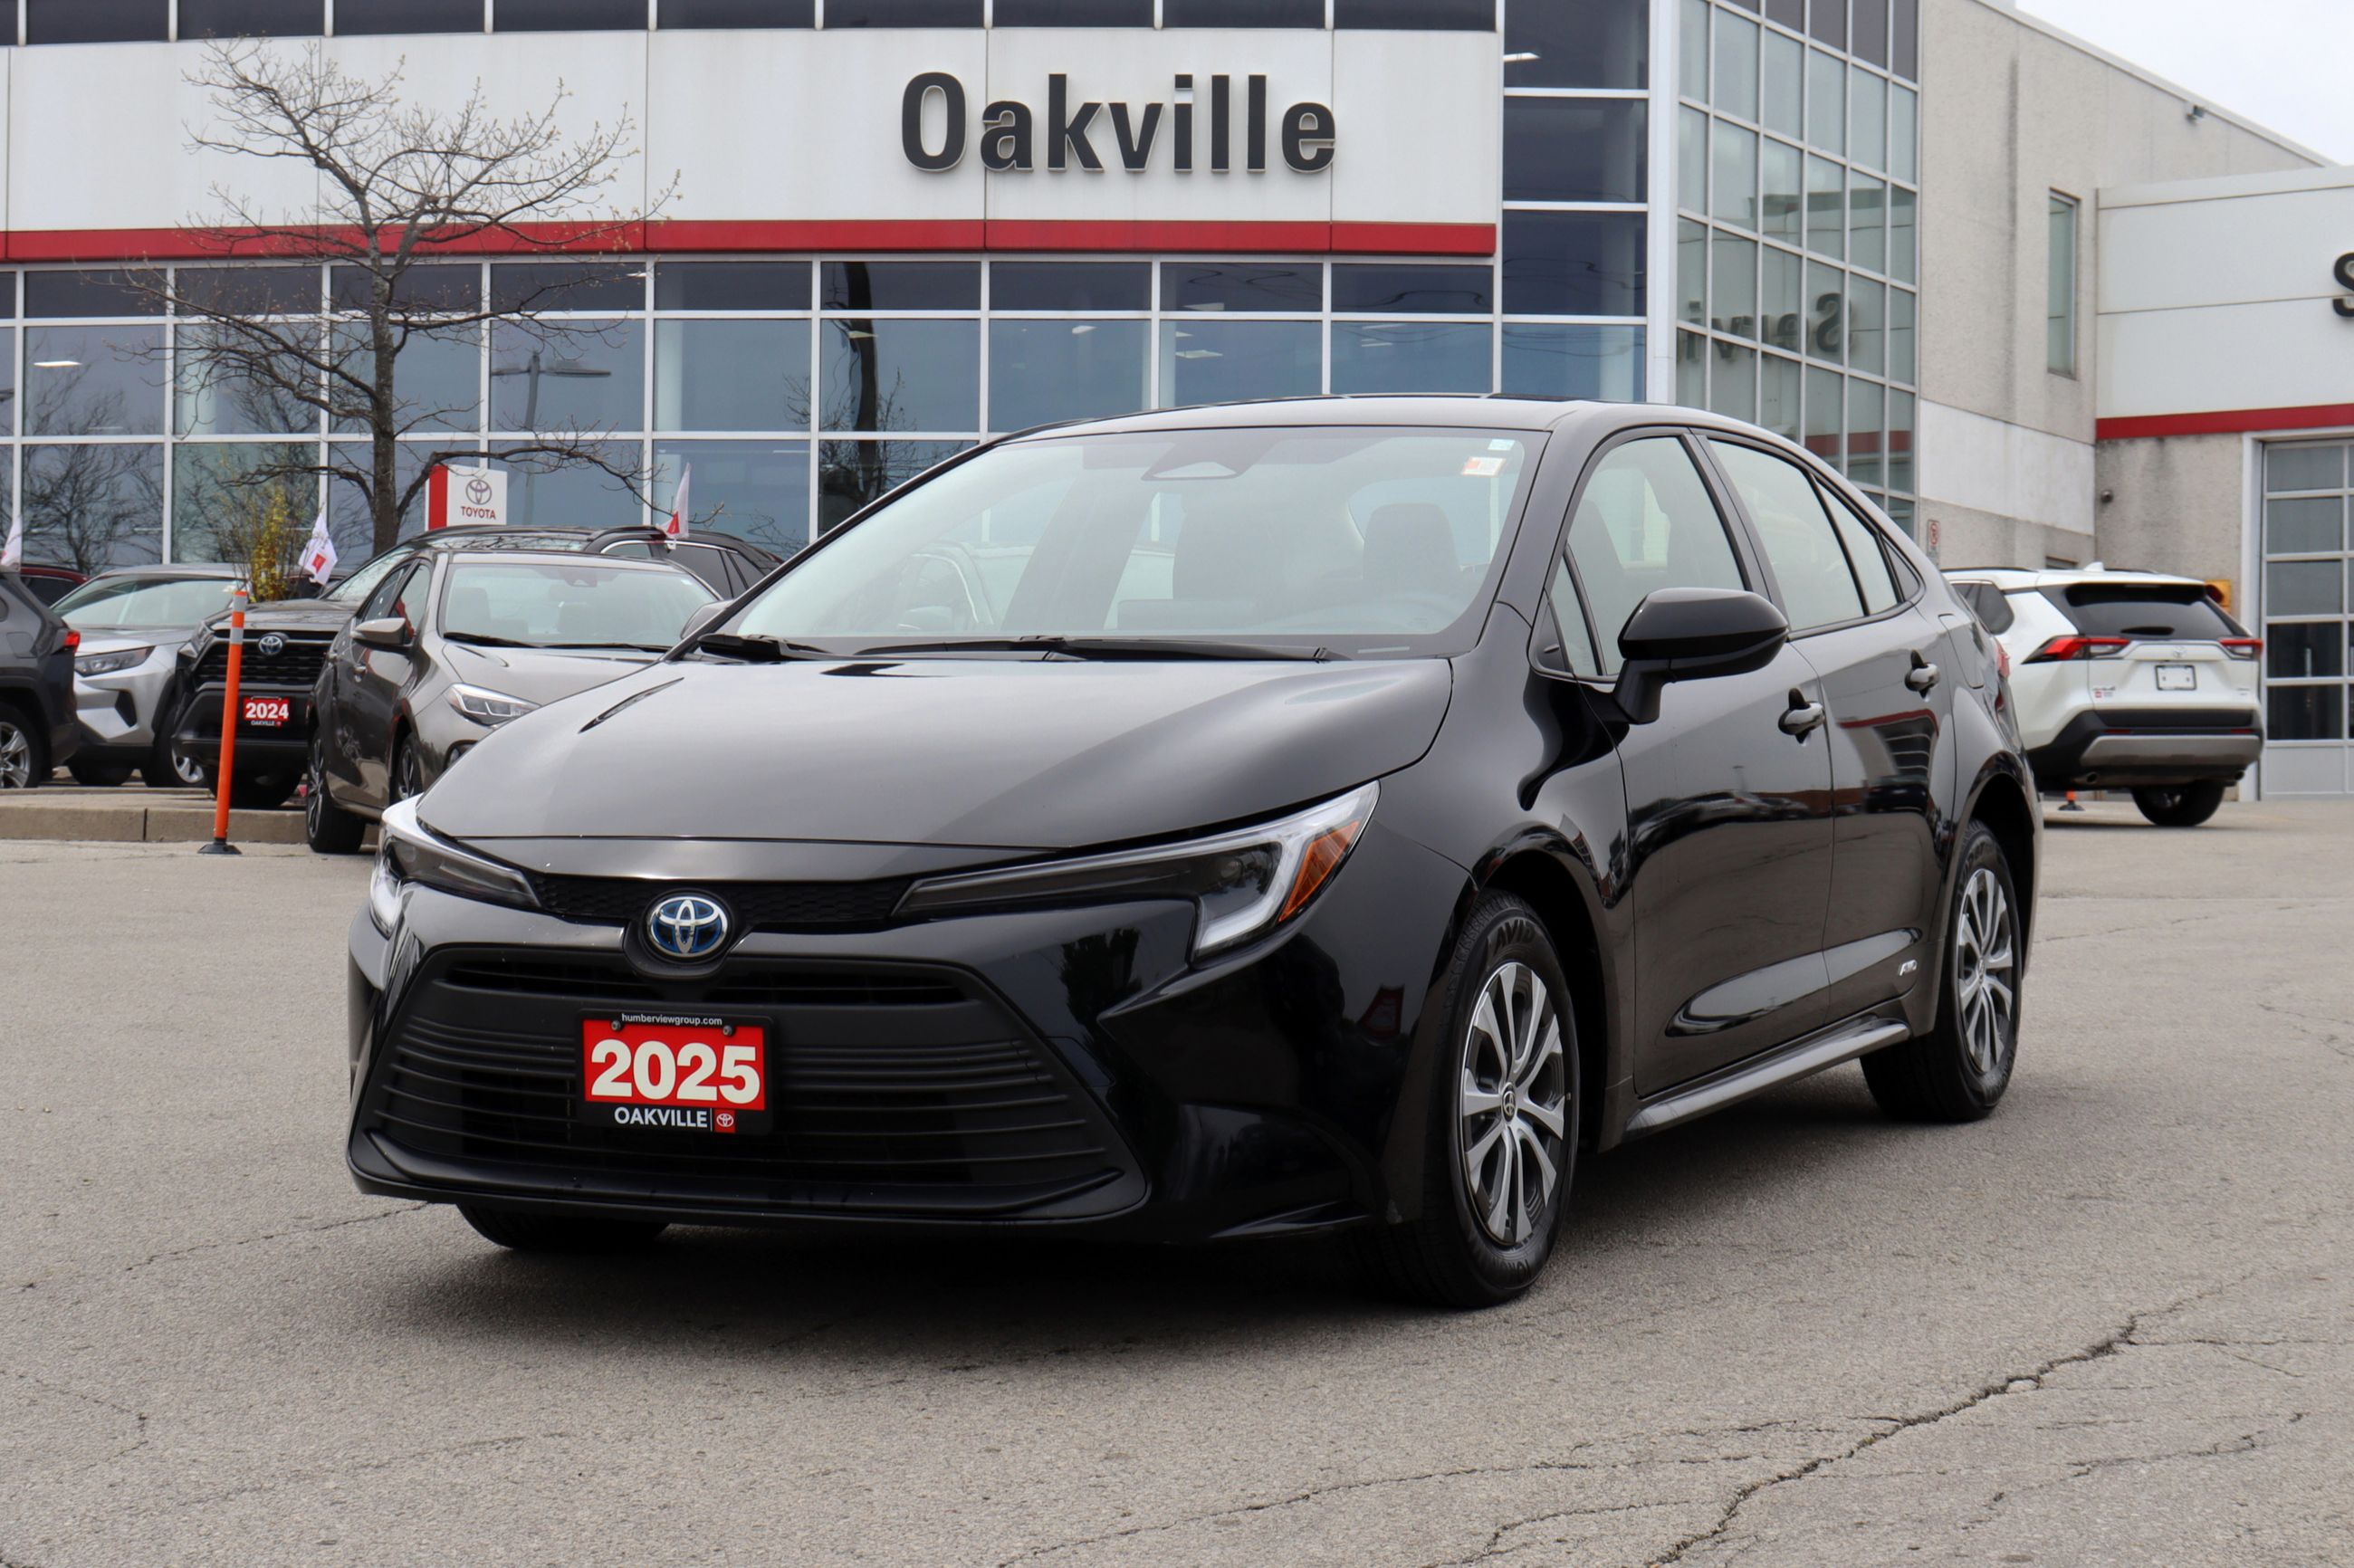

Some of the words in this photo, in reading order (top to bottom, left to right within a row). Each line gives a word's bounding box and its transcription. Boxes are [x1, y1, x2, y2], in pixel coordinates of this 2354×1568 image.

[902, 72, 1336, 174] Oakville
[461, 506, 496, 520] TOYOTA
[245, 702, 290, 720] 2024
[621, 1013, 722, 1027] humberviewgroup.com
[591, 1038, 761, 1104] 2025
[614, 1106, 708, 1128] OAKVILLE
